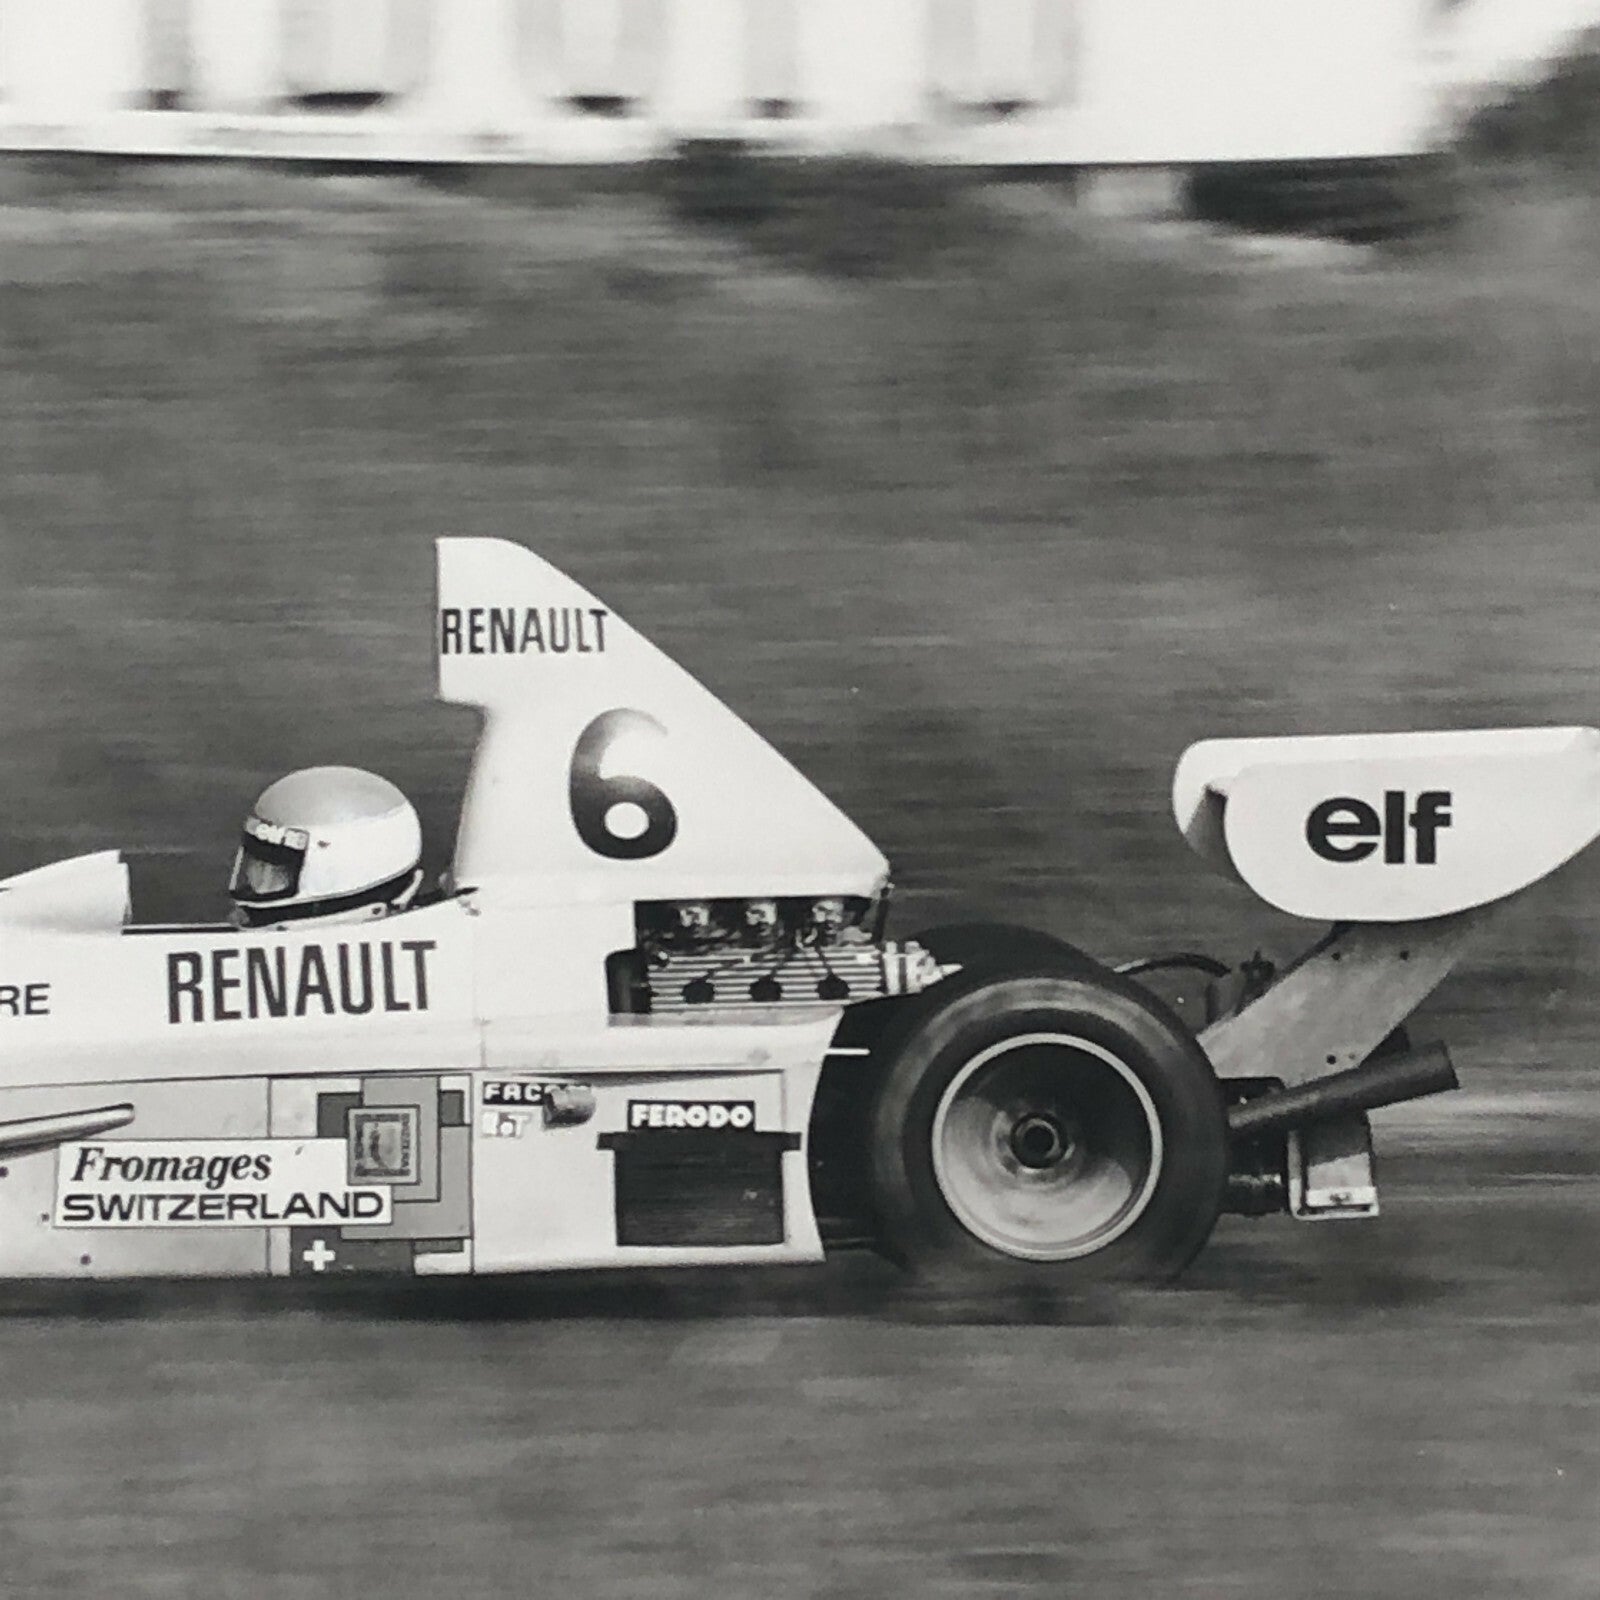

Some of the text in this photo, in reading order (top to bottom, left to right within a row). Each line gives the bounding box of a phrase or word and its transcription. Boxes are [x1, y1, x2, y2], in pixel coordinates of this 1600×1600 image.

[441, 609, 607, 655] RENAULT
[569, 708, 679, 860] 6
[1305, 790, 1453, 865] elf
[167, 940, 436, 1024] RENAULT
[631, 1104, 753, 1128] FERODO
[72, 1147, 272, 1190] Fromages
[63, 1192, 383, 1221] SWITZERLAND
